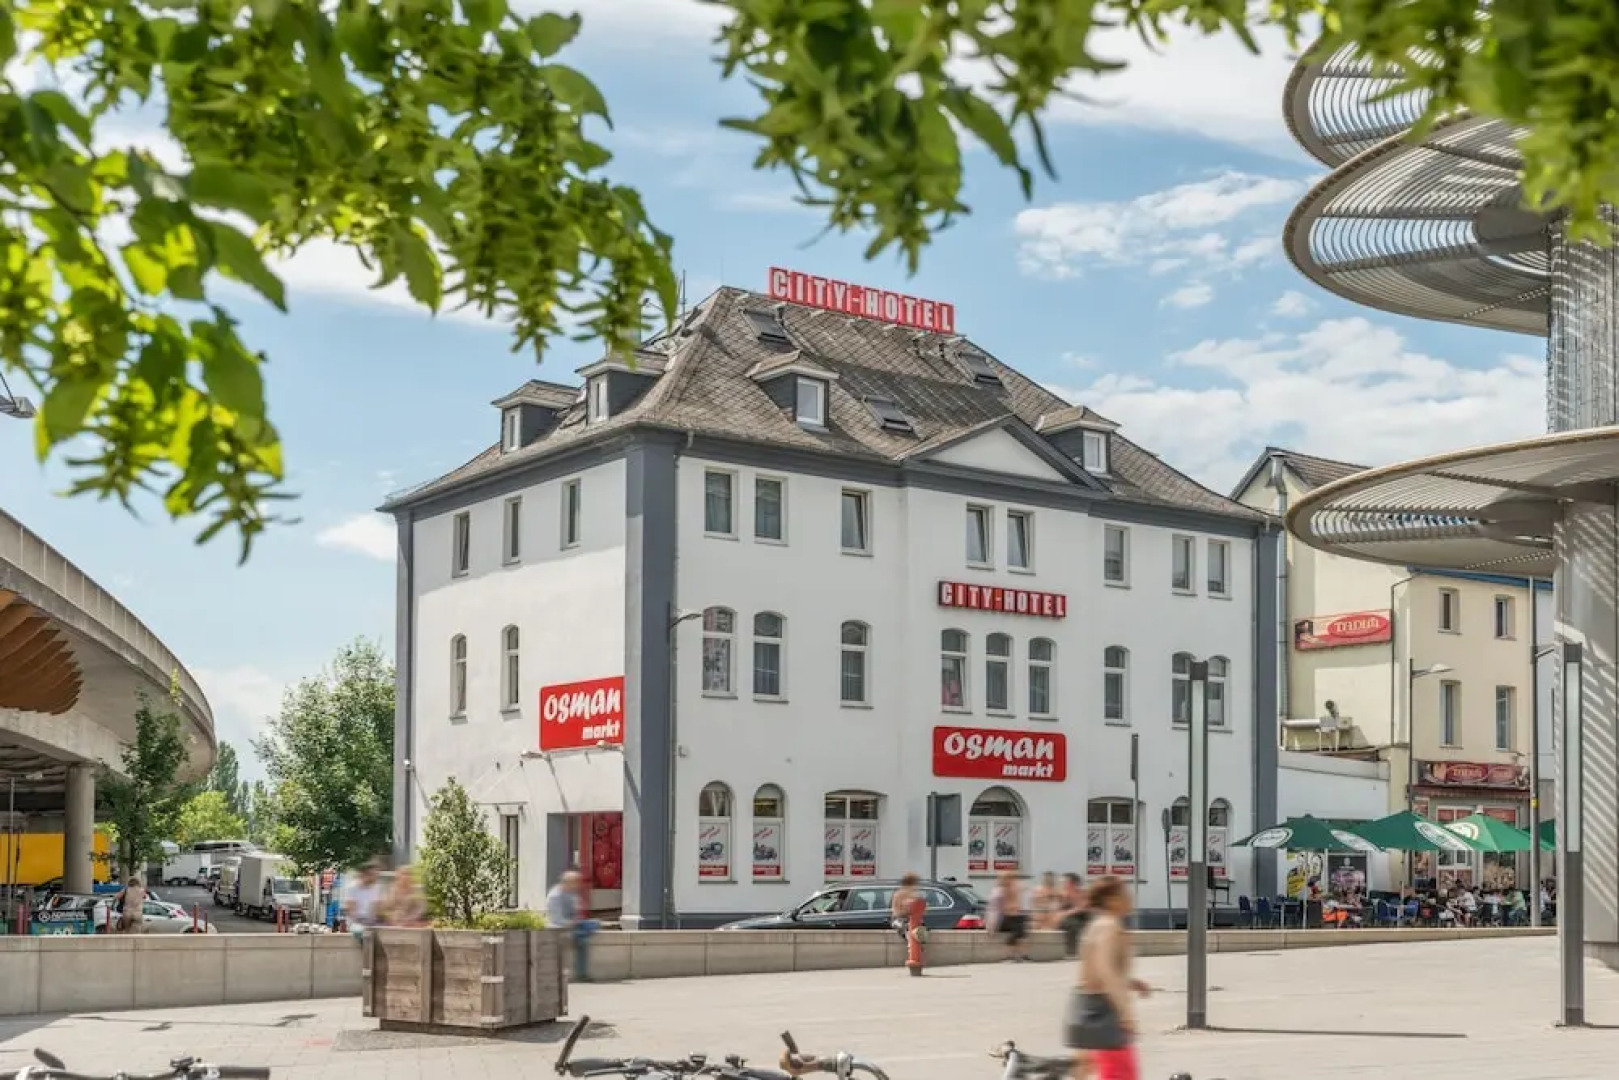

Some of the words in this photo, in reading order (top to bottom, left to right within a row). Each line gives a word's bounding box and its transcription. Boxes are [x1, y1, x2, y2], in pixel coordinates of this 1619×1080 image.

[772, 270, 951, 331] CITY-HOTEL
[941, 583, 1064, 616] CITY-HOTEL
[582, 719, 620, 740] markt
[1002, 763, 1054, 778] markt
